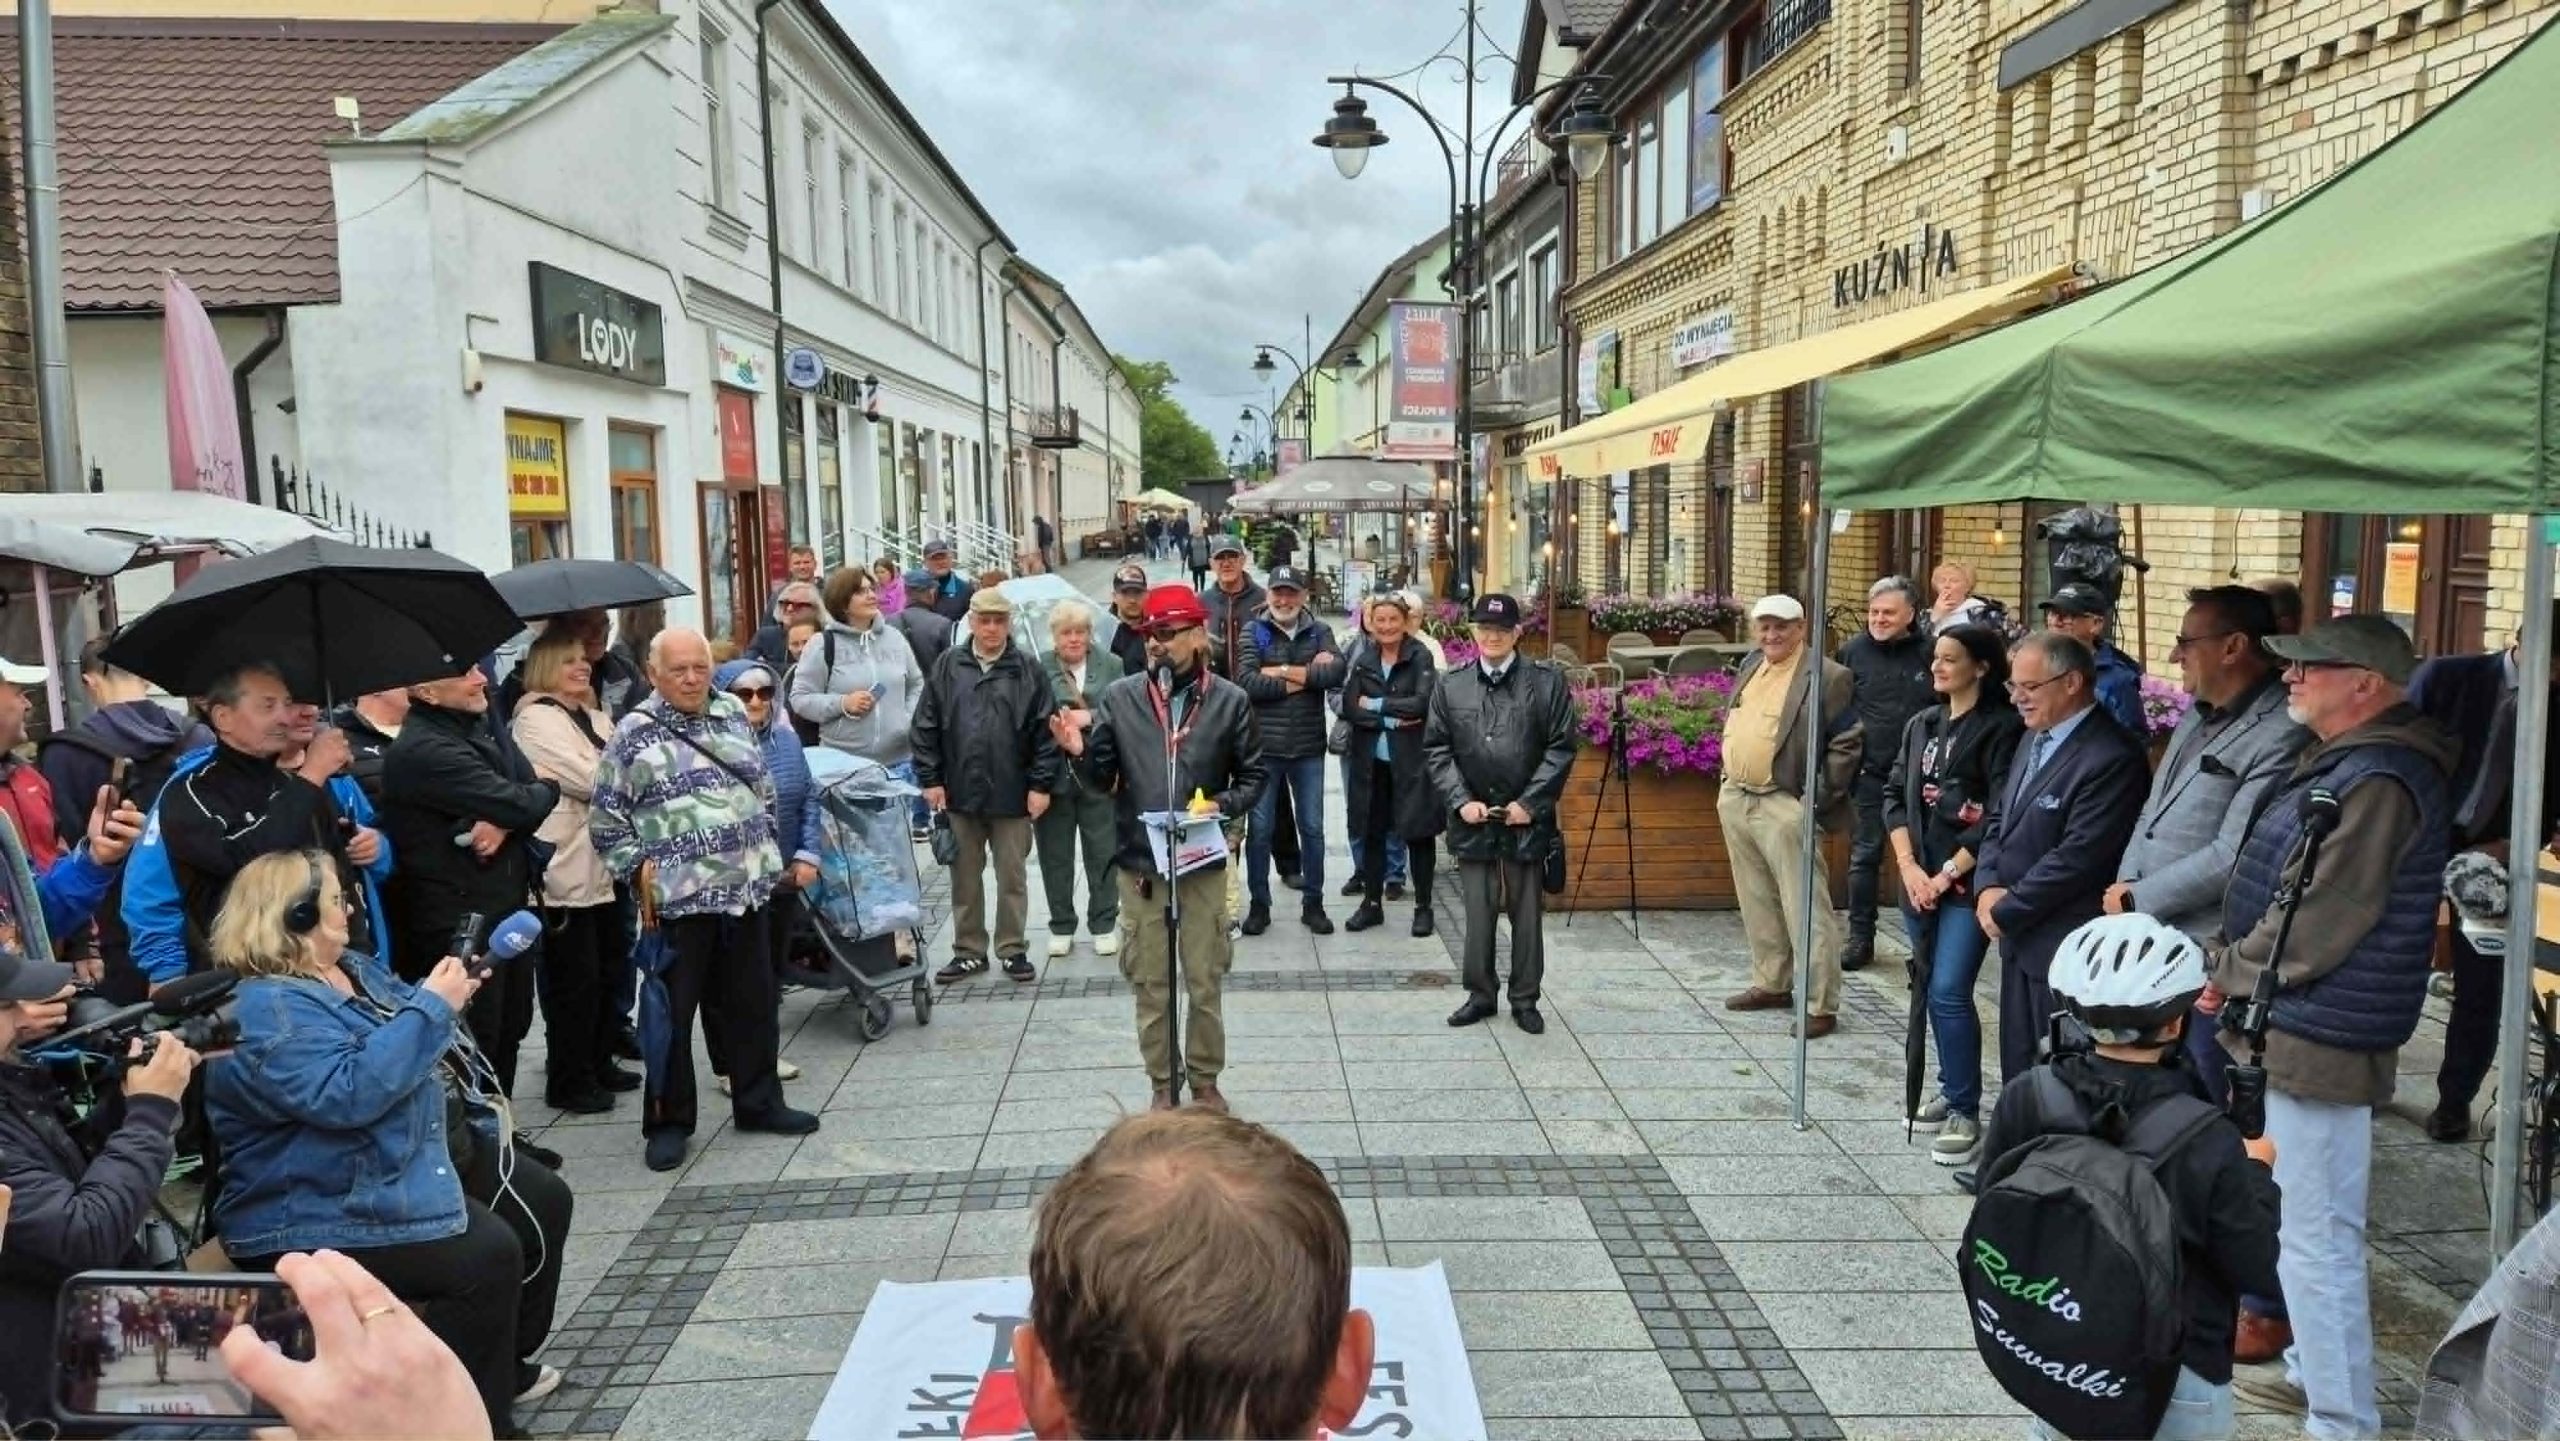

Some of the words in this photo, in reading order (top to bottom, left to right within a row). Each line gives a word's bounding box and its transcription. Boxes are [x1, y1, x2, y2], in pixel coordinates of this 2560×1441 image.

[1834, 223, 1957, 309] KUŹNIA
[578, 313, 637, 371] LODY
[1974, 1238, 2081, 1322] Radio
